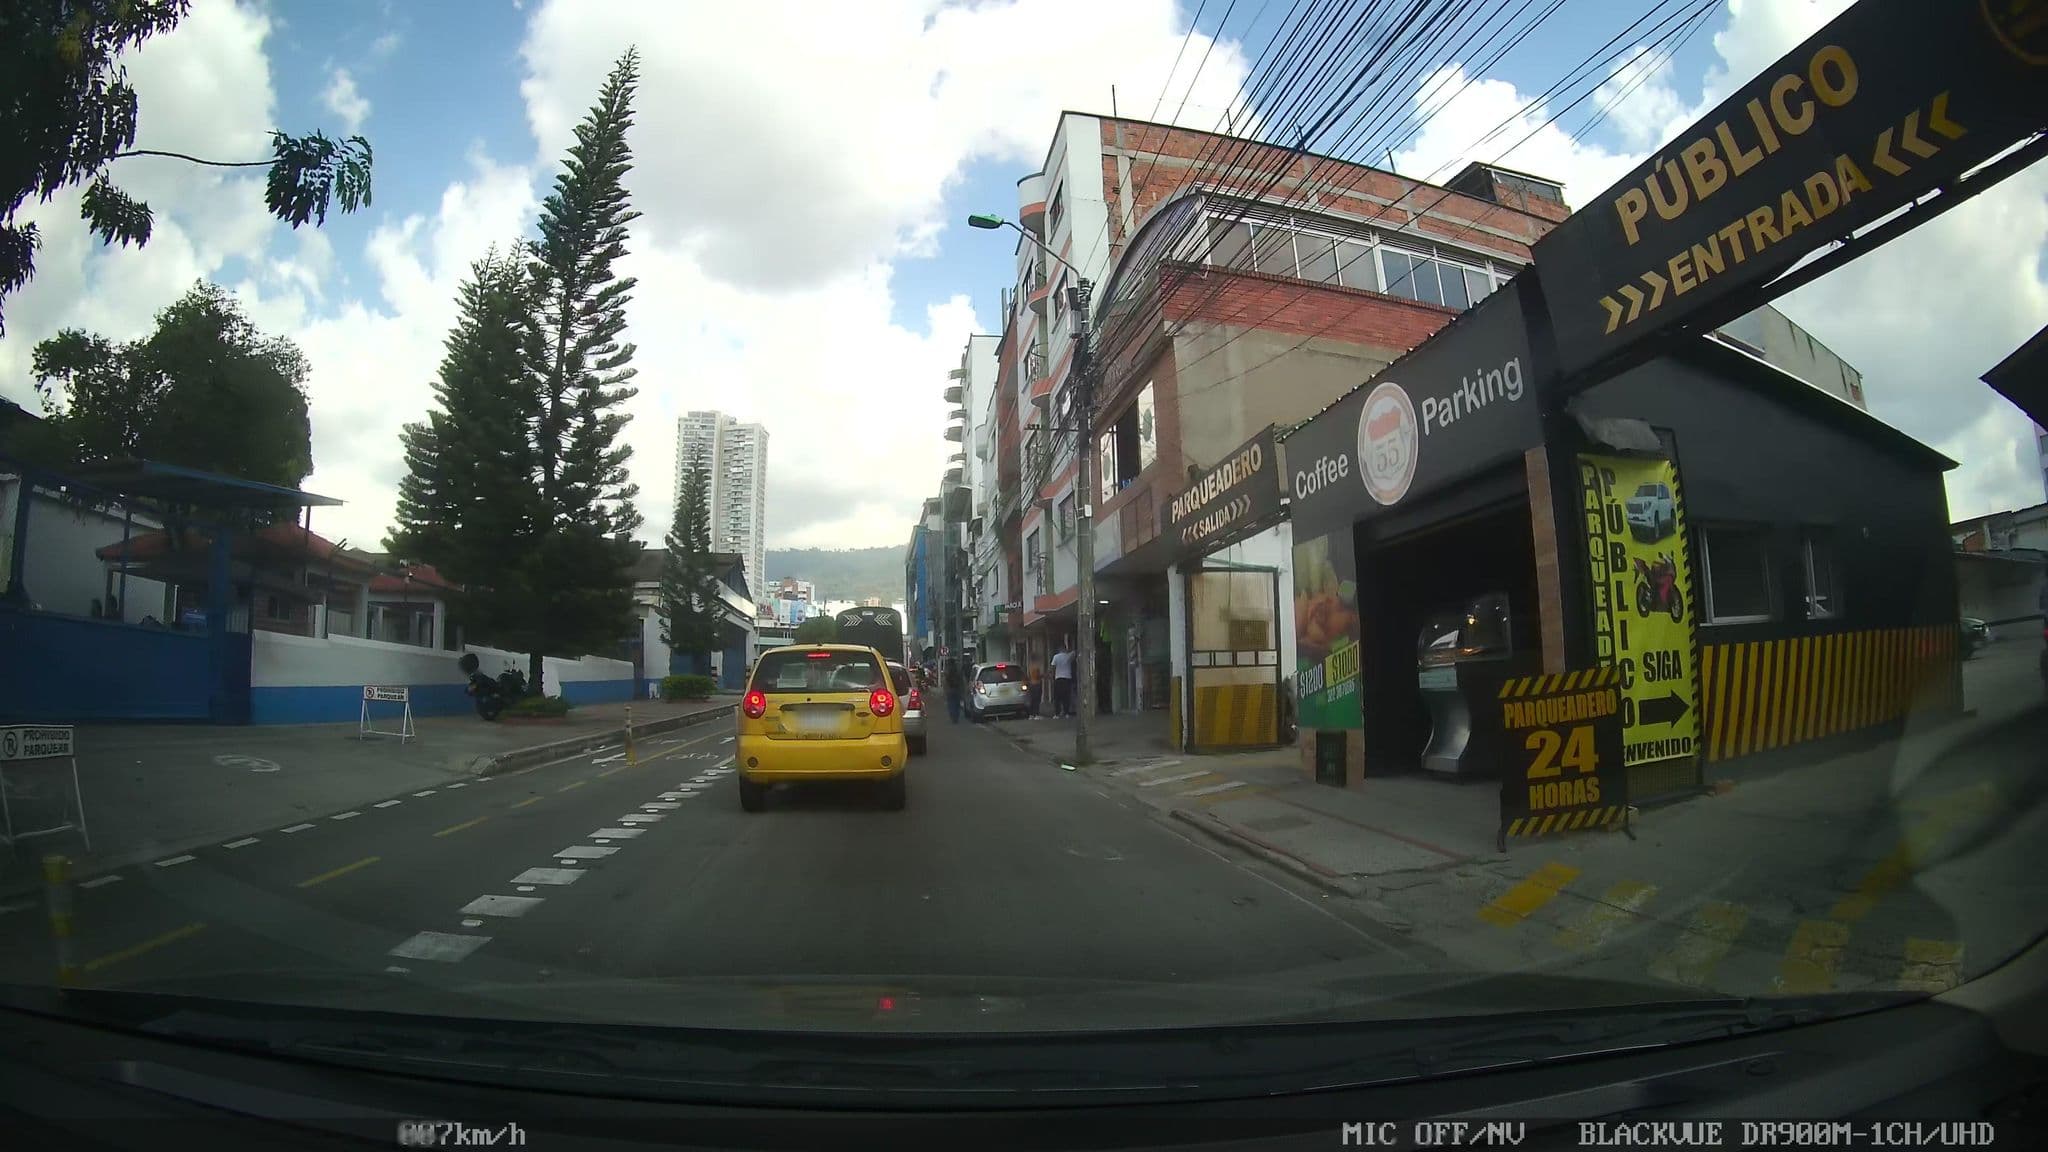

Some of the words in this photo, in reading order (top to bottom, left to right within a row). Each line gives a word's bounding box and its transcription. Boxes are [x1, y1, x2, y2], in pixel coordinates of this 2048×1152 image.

[1614, 45, 1859, 246] PÚBLICO
[1667, 153, 1873, 297] ENTRADA
[1421, 357, 1524, 436] Parking
[1295, 453, 1349, 499] Coffee
[1376, 438, 1400, 473] 55
[1171, 443, 1262, 524] PARQUEADERO
[1199, 505, 1231, 538] SALIDA
[1582, 466, 1612, 667] PARQUEAD
[1600, 467, 1636, 729] PÚBLICO
[1300, 663, 1323, 700] $1200
[1332, 643, 1358, 684] $1000
[1643, 650, 1682, 683] SIGA
[1503, 689, 1616, 730] PARQUEADERO
[23, 743, 69, 756] PARQUEAR
[1526, 724, 1600, 780] 24
[1624, 736, 1691, 763] NVENIDO
[1528, 777, 1601, 811] HORAS
